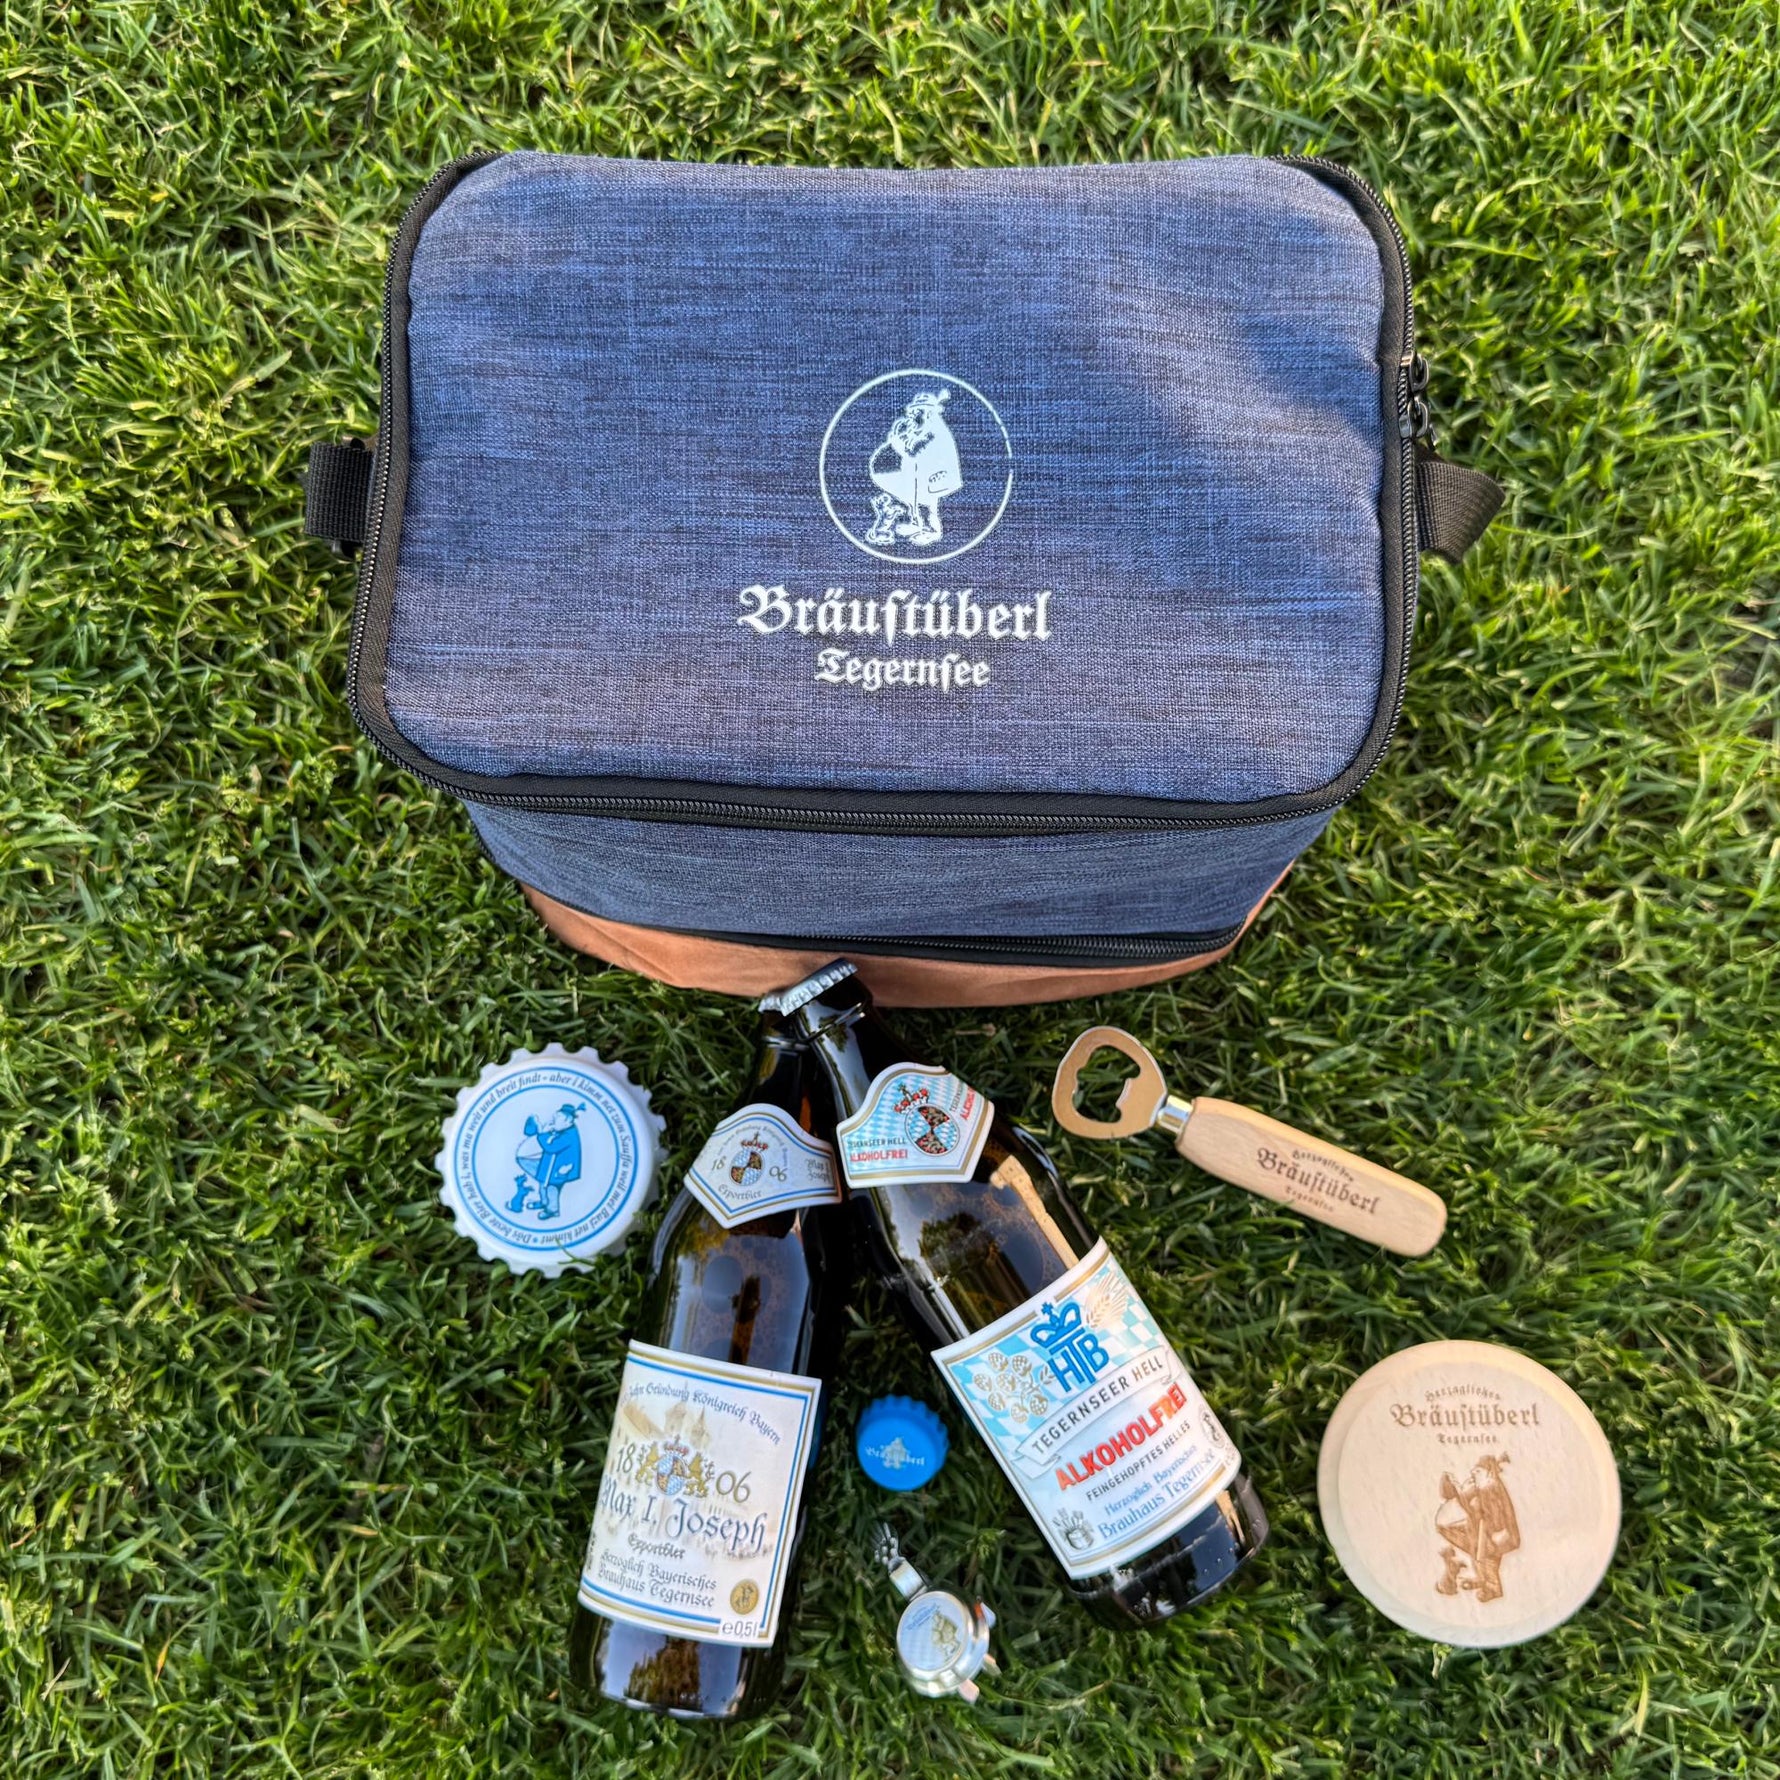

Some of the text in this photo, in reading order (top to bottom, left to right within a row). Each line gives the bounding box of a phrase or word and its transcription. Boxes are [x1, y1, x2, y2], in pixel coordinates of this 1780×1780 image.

[493, 1078, 518, 1097] breit
[549, 1072, 571, 1084] aber
[477, 1091, 497, 1112] und
[600, 1098, 616, 1114] net
[466, 1110, 482, 1131] weit
[711, 1156, 788, 1182] 18 06
[463, 1180, 478, 1200] hab
[471, 1199, 491, 1220] Bier
[487, 1215, 512, 1236] beste
[1032, 1355, 1164, 1455] TEGERNSEER HELL
[1055, 1383, 1187, 1491] ALKOHOLFREI
[1086, 1420, 1192, 1501] FEINGEHOPFTES HELLES
[616, 1443, 752, 1503] 18 06
[601, 1474, 636, 1523] Max
[665, 1497, 767, 1555] Joseph
[1097, 1493, 1165, 1539] Brauhaus
[650, 1579, 715, 1608] Tegernsee
